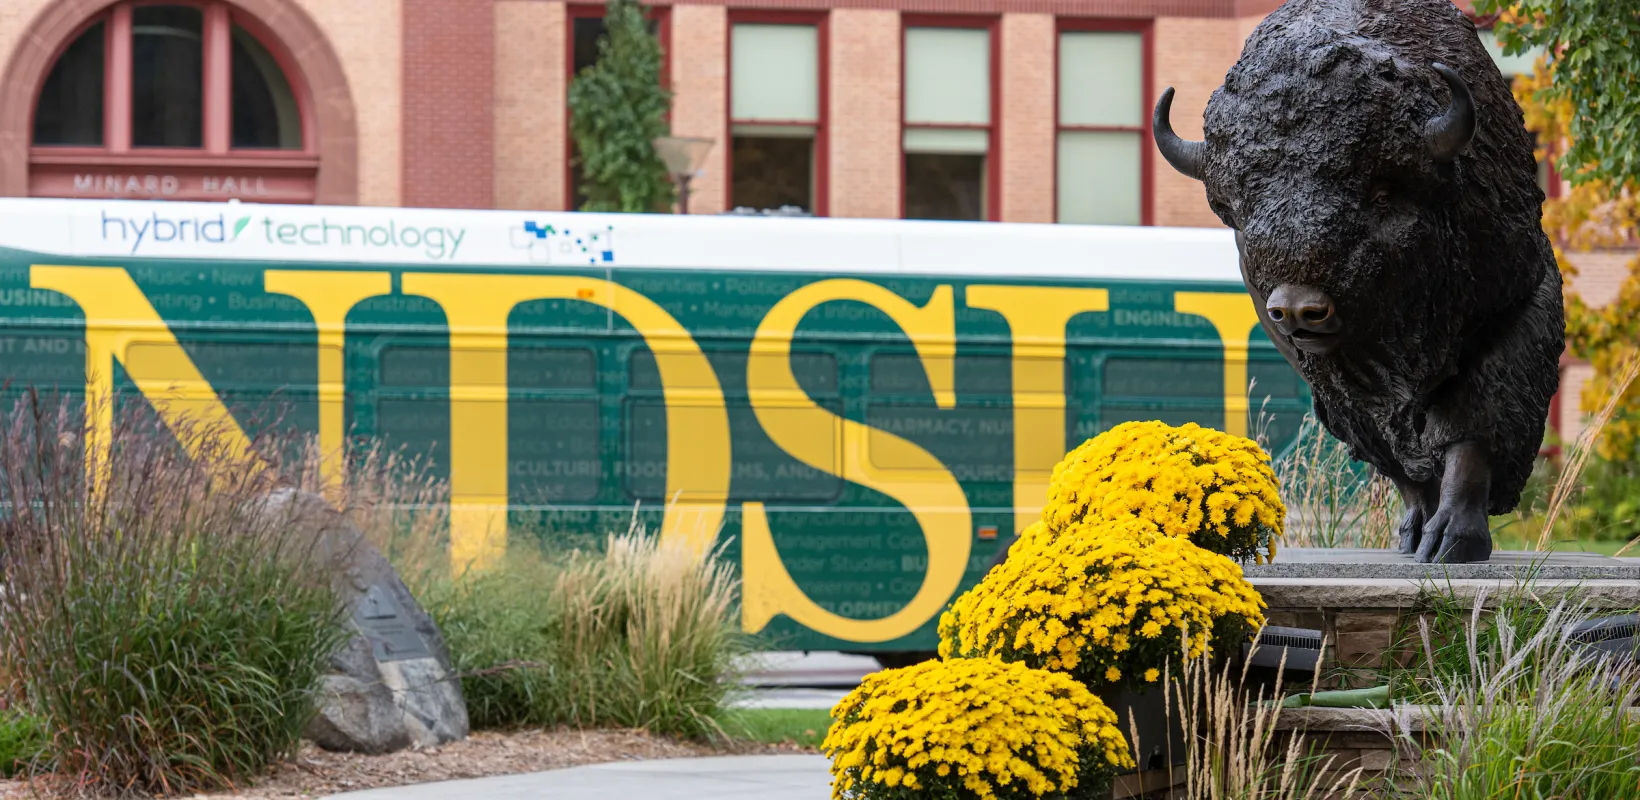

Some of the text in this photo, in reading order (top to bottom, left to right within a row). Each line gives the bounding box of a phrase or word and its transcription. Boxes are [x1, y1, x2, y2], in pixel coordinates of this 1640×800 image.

[73, 174, 269, 196] MINARD HALL
[101, 210, 466, 259] hybrid technology
[22, 338, 69, 354] AND
